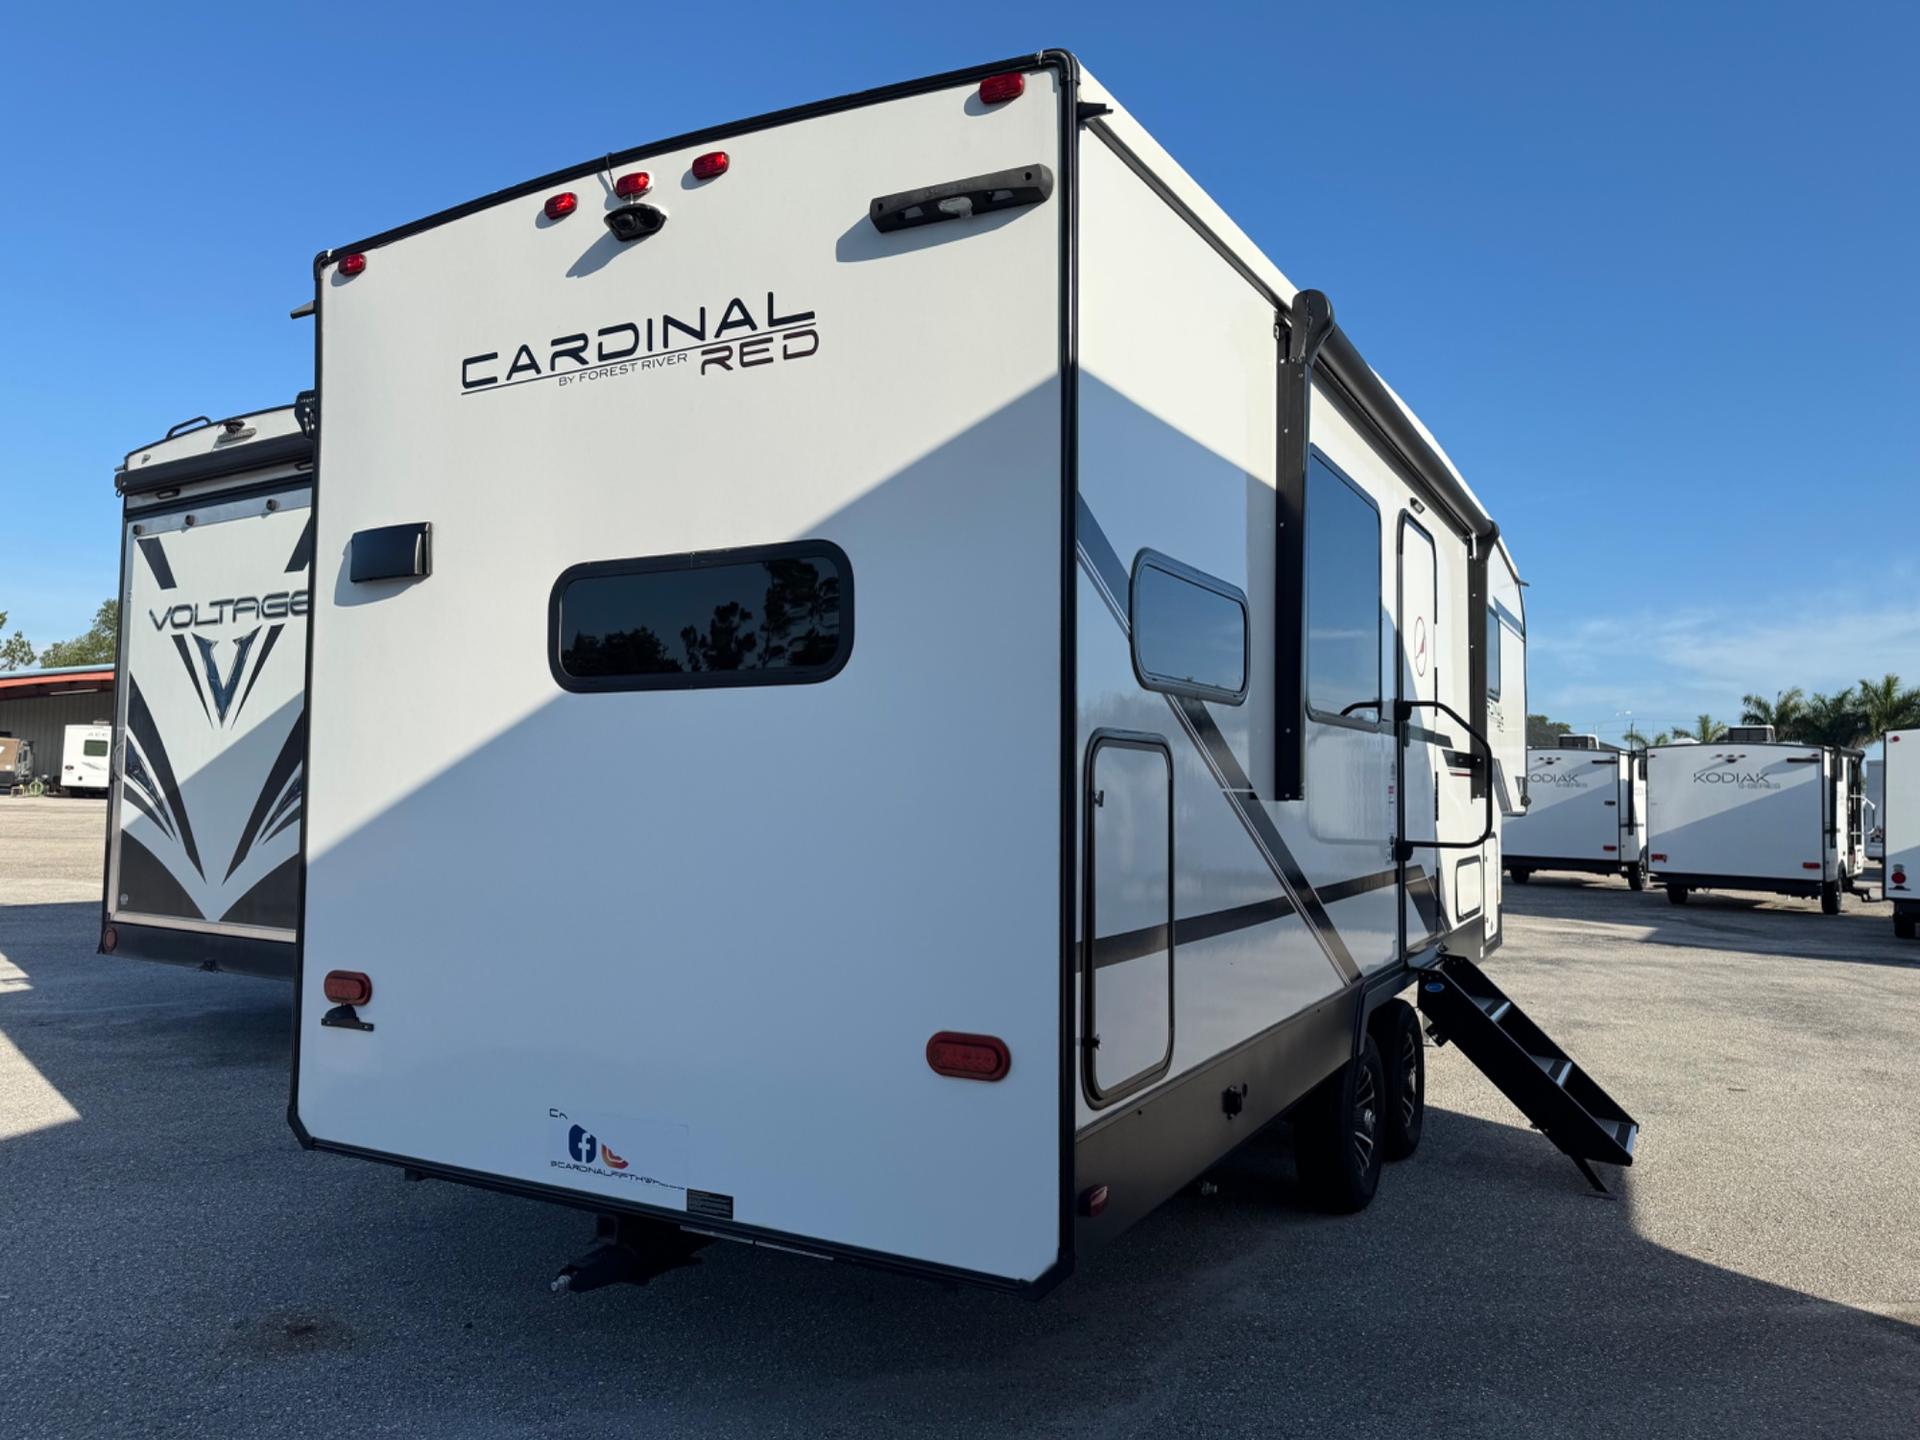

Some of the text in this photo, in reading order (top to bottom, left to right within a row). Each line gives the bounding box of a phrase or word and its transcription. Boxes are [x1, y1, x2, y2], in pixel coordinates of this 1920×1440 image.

[461, 291, 816, 390] CARDINAL
[700, 329, 820, 375] RED
[558, 352, 688, 387] BY FOREST RIVER
[148, 590, 309, 632] VOLTAGE
[1693, 772, 1770, 784] KODIAK
